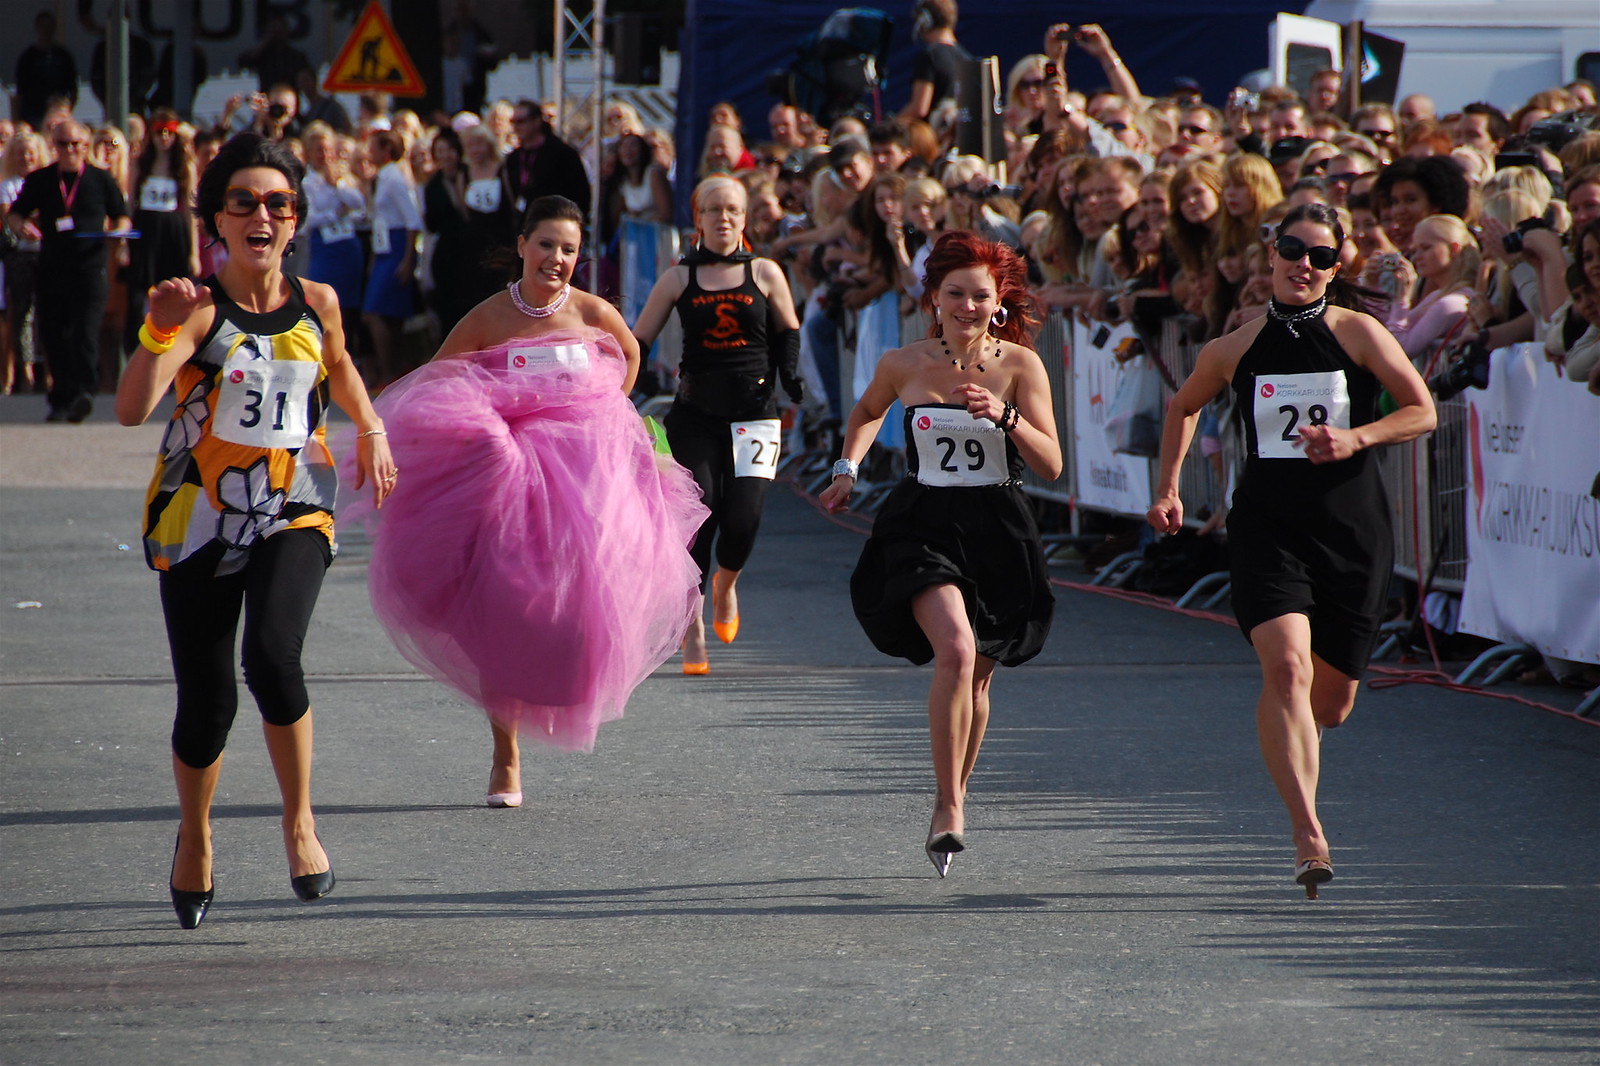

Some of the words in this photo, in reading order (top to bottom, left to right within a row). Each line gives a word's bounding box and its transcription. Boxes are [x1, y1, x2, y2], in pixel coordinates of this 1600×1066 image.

[240, 390, 287, 430] 31
[1279, 404, 1328, 441] 28
[751, 440, 778, 467] 27
[936, 437, 985, 472] 29
